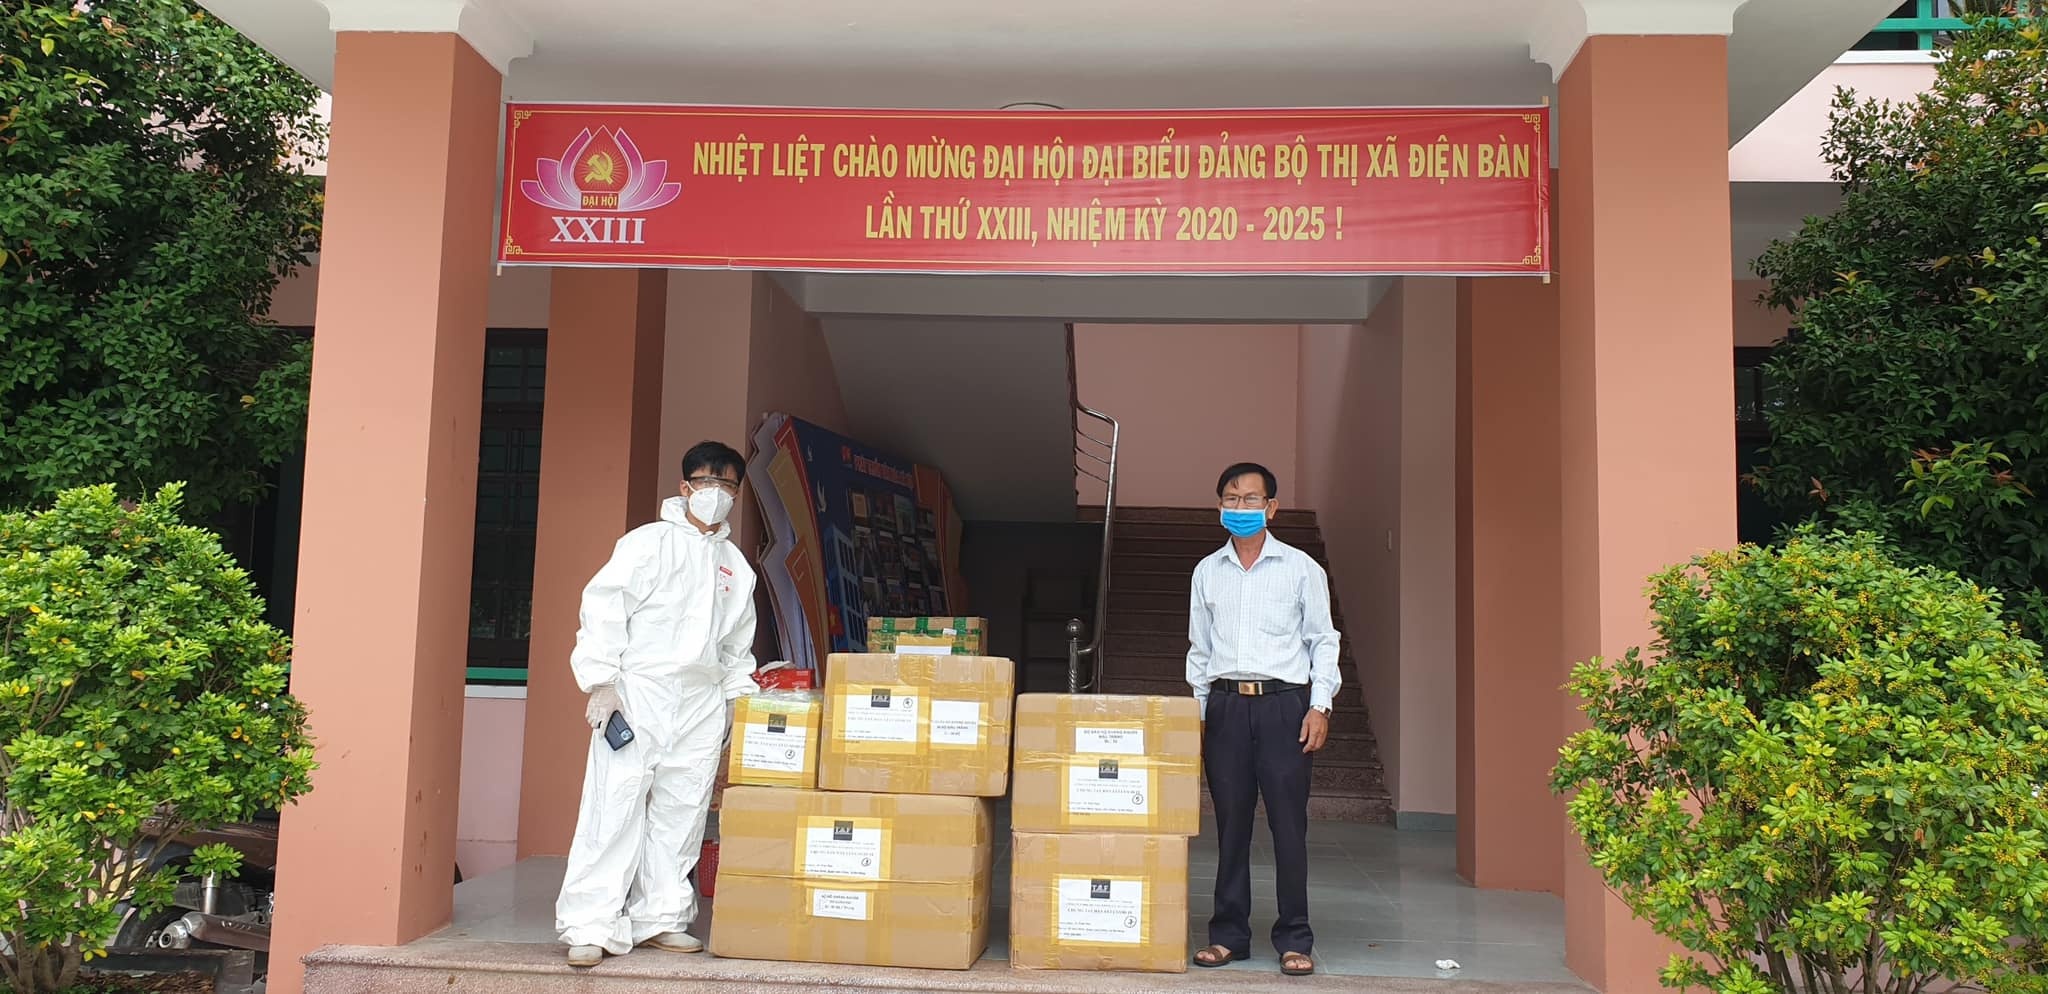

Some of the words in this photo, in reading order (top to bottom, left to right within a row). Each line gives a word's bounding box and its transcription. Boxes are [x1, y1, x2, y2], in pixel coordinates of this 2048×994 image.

[693, 133, 765, 182] NHIỆT
[772, 135, 825, 183] LIỆT
[833, 136, 898, 178] CHÀO
[906, 136, 976, 180] MỪNG
[983, 144, 1024, 186] ĐẠI
[1033, 136, 1074, 186] HỘI
[1083, 144, 1123, 185] ĐẠI
[1133, 128, 1189, 179] BIỂU
[1199, 131, 1266, 179] ĐẢNG
[1274, 135, 1309, 185] BỘ
[1317, 144, 1358, 186] THỊ
[1366, 135, 1400, 178] XÃ
[1408, 135, 1469, 185] ĐIỆN
[1478, 135, 1530, 178] BÀN
[582, 195, 598, 208] ĐẠI
[601, 193, 617, 209] HỘI
[865, 191, 912, 239] LẦN
[920, 197, 971, 240] THỨ
[976, 205, 1038, 247] XXIII,
[1047, 198, 1126, 247] NHIỆM
[1134, 198, 1167, 241] KỲ
[1177, 206, 1239, 241] 2020
[1247, 224, 1255, 232] -
[1263, 205, 1326, 241] 2025
[1336, 206, 1344, 240] !
[550, 216, 647, 244] XXIII
